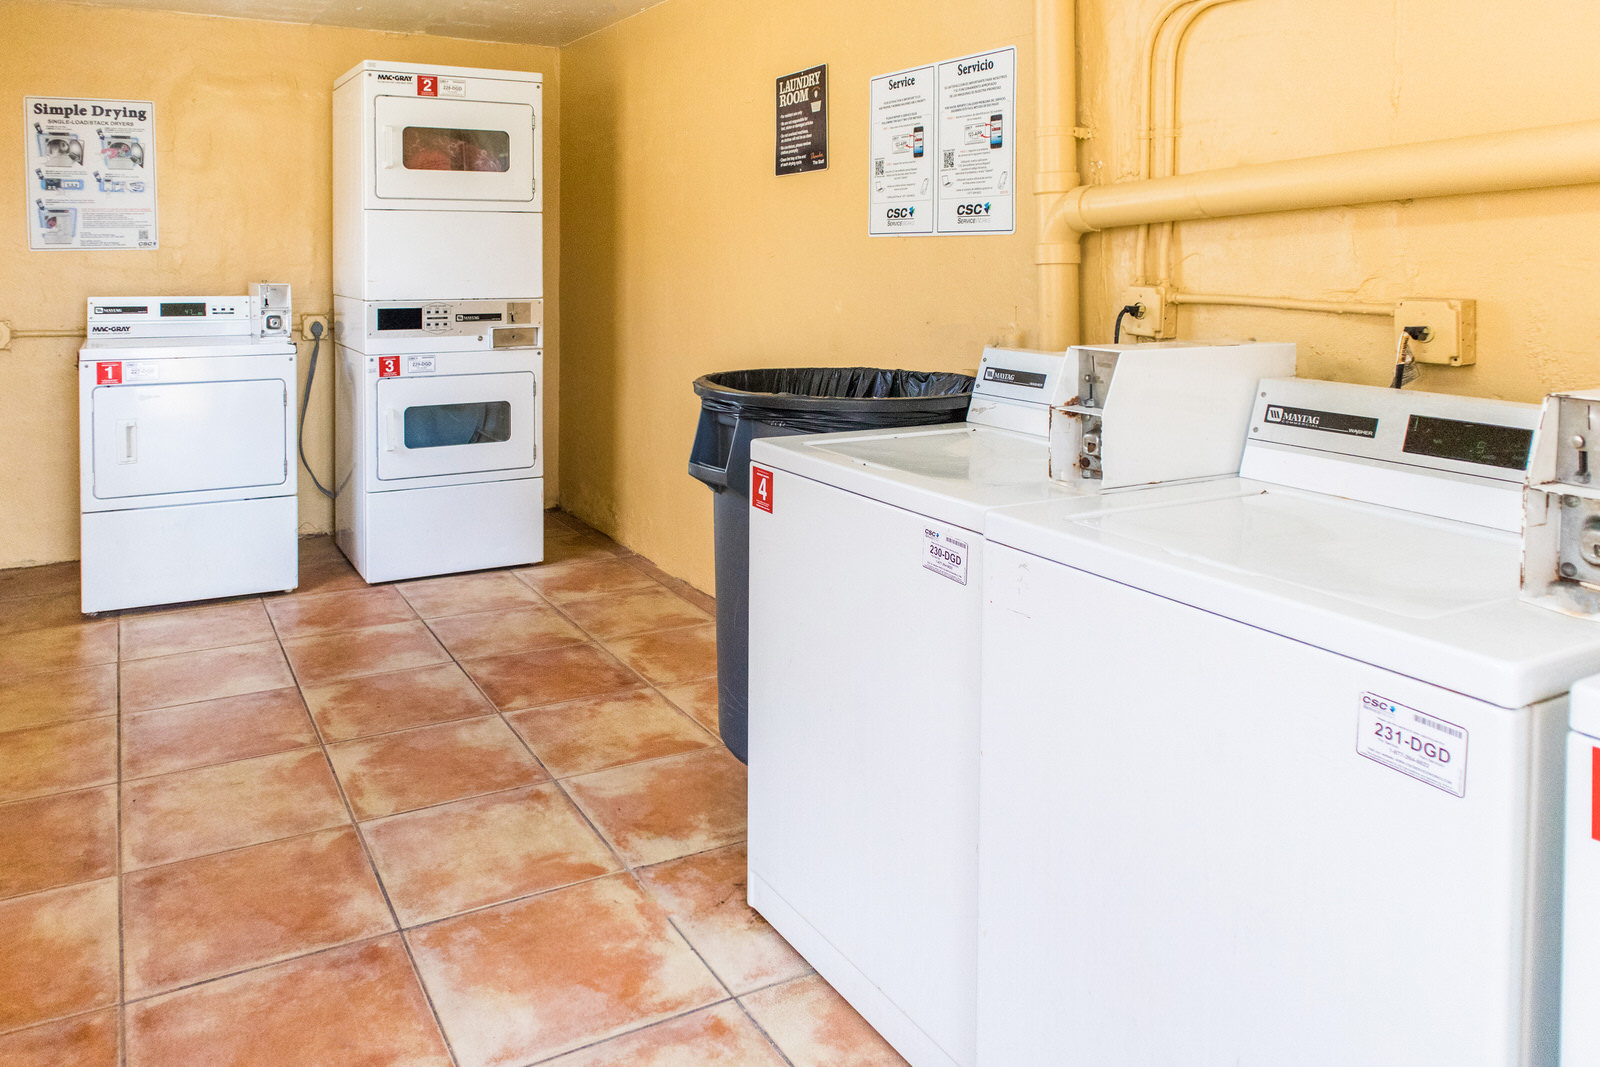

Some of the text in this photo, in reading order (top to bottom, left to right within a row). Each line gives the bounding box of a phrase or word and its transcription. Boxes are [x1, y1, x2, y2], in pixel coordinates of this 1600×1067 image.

[957, 58, 994, 76] Servicio
[423, 79, 432, 92] 2
[779, 71, 821, 95] LAUNDRY
[888, 76, 916, 91] Service
[779, 88, 809, 108] ROOM
[33, 103, 147, 121] Simple Drying
[886, 207, 908, 219] CSC
[956, 203, 983, 216] CSC
[104, 366, 112, 379] 1
[385, 360, 394, 372] 3
[1282, 412, 1320, 425] MAYTAG
[758, 477, 767, 501] 4
[924, 528, 936, 538] CSC
[930, 544, 962, 566] 230-DGD
[1362, 695, 1388, 710] CSC
[1374, 722, 1451, 763] 231-DGD
